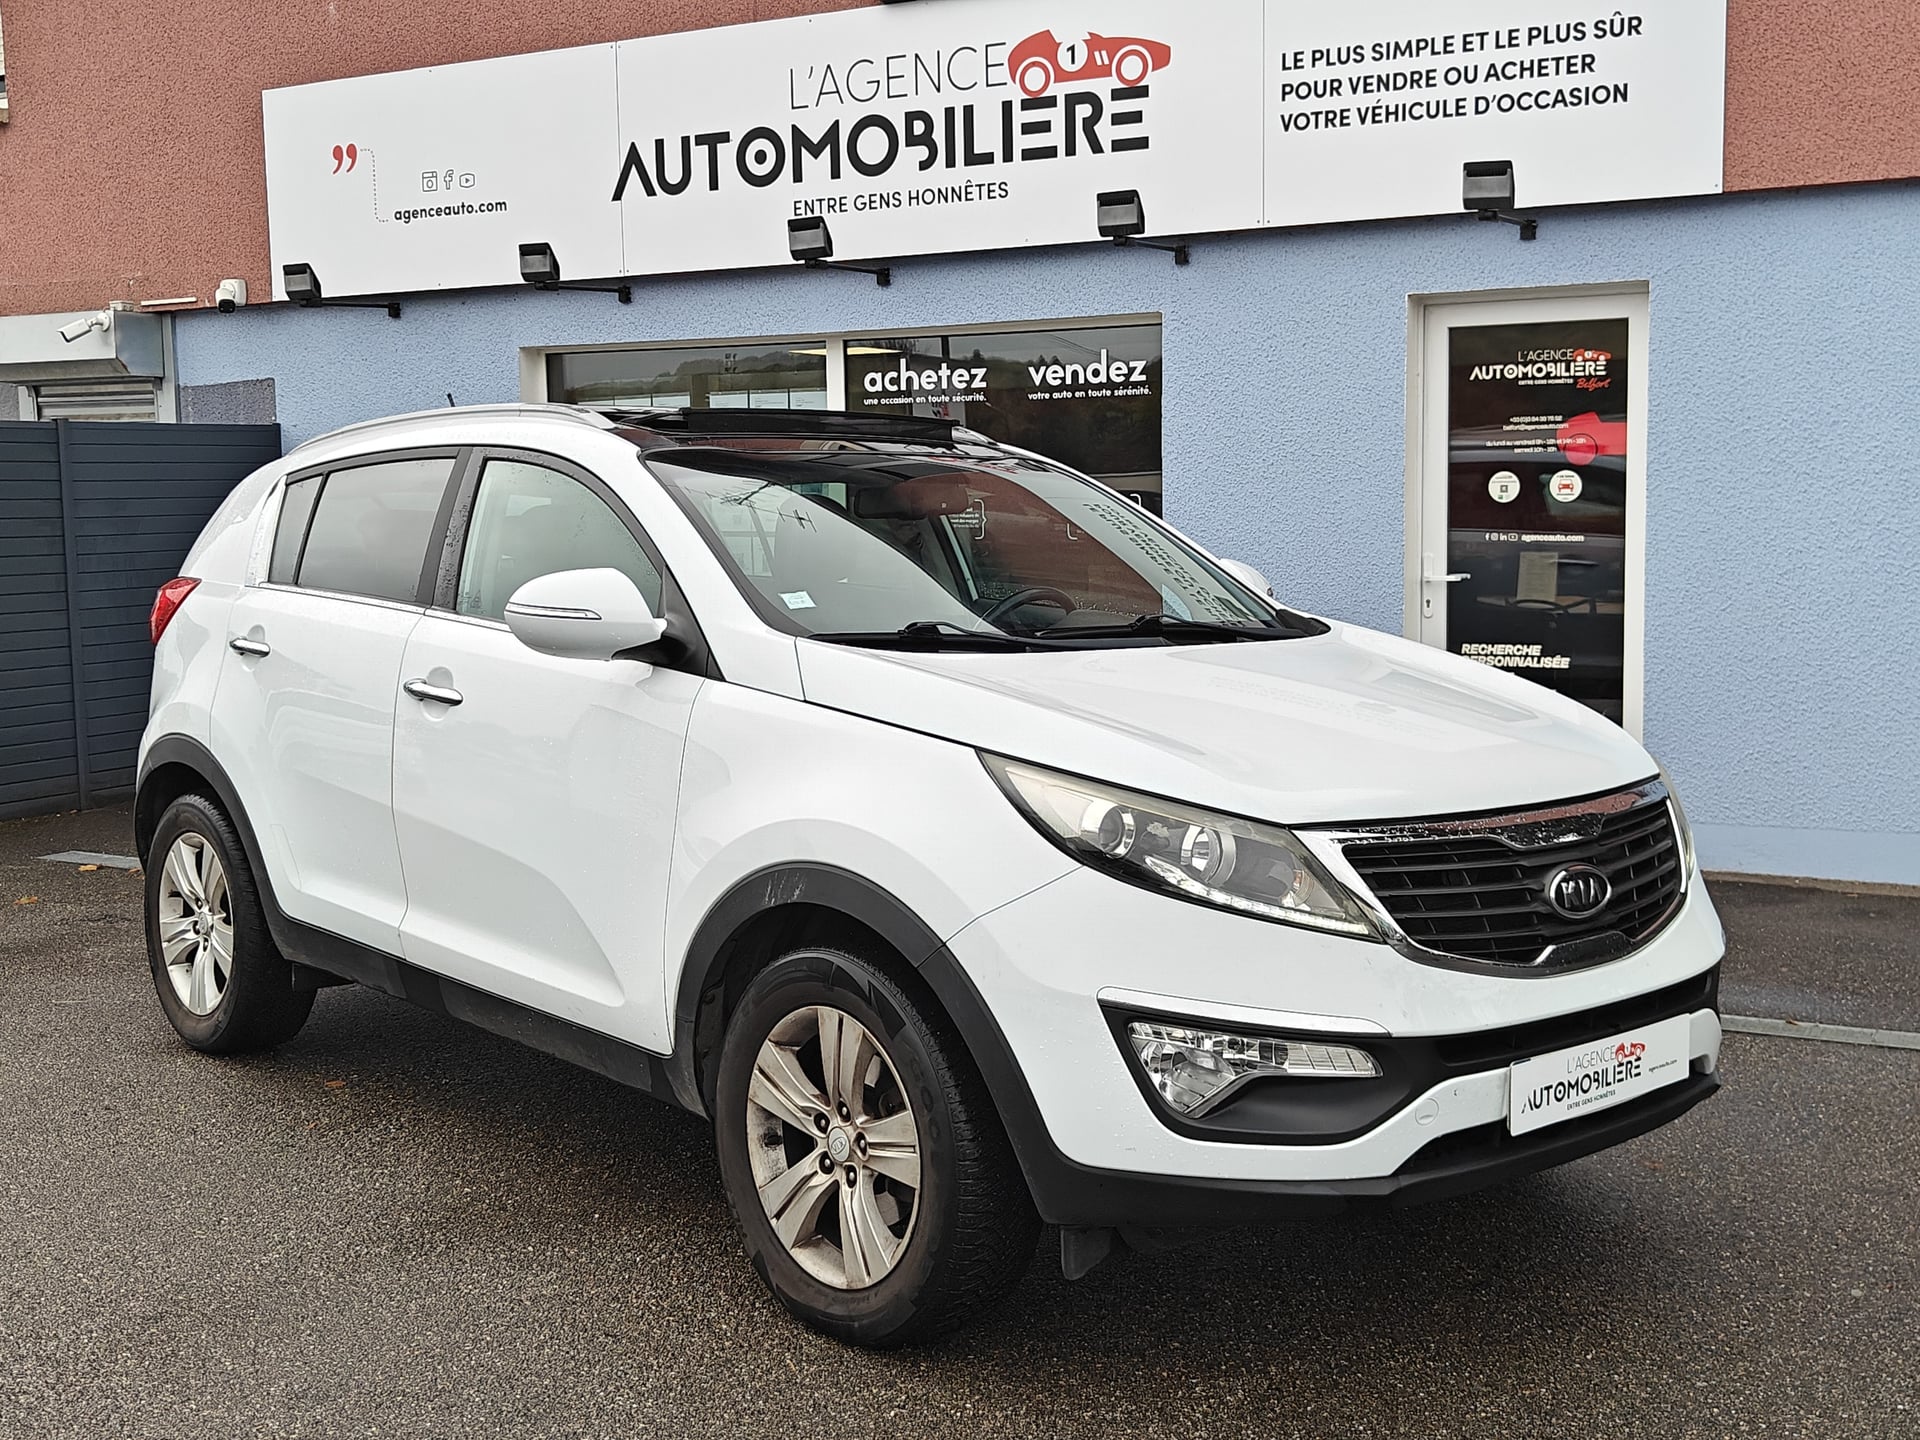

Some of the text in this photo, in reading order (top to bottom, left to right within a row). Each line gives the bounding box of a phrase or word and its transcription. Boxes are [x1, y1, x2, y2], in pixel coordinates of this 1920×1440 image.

[1281, 11, 1643, 71] LE PLUS SIMPLE ET LE PLUS SÛR
[790, 42, 1007, 110] L'AGENCE
[1281, 54, 1596, 101] POUR VENDRE OU ACHETER
[1280, 83, 1629, 132] VOTRE VÉHICULE D'OCCASION
[394, 201, 507, 224] agenceauto.com
[793, 180, 1009, 217] ENTRE GENS HONNÊTES
[1028, 348, 1148, 387] vendez
[1518, 349, 1573, 362] L'AGENCE
[864, 358, 987, 393] achetez
[1576, 378, 1611, 391] Belfort
[880, 395, 914, 404] occasion
[928, 394, 950, 403] toute
[952, 392, 987, 402] sécurité.
[1028, 392, 1050, 400] votre
[1052, 390, 1072, 399] auto
[1088, 388, 1111, 397] toute
[1114, 384, 1152, 396] sérénité.
[1521, 534, 1585, 542] agenceauto.com
[1461, 644, 1542, 656] RECHERCHE
[1567, 1045, 1616, 1074] L'AGENCE
